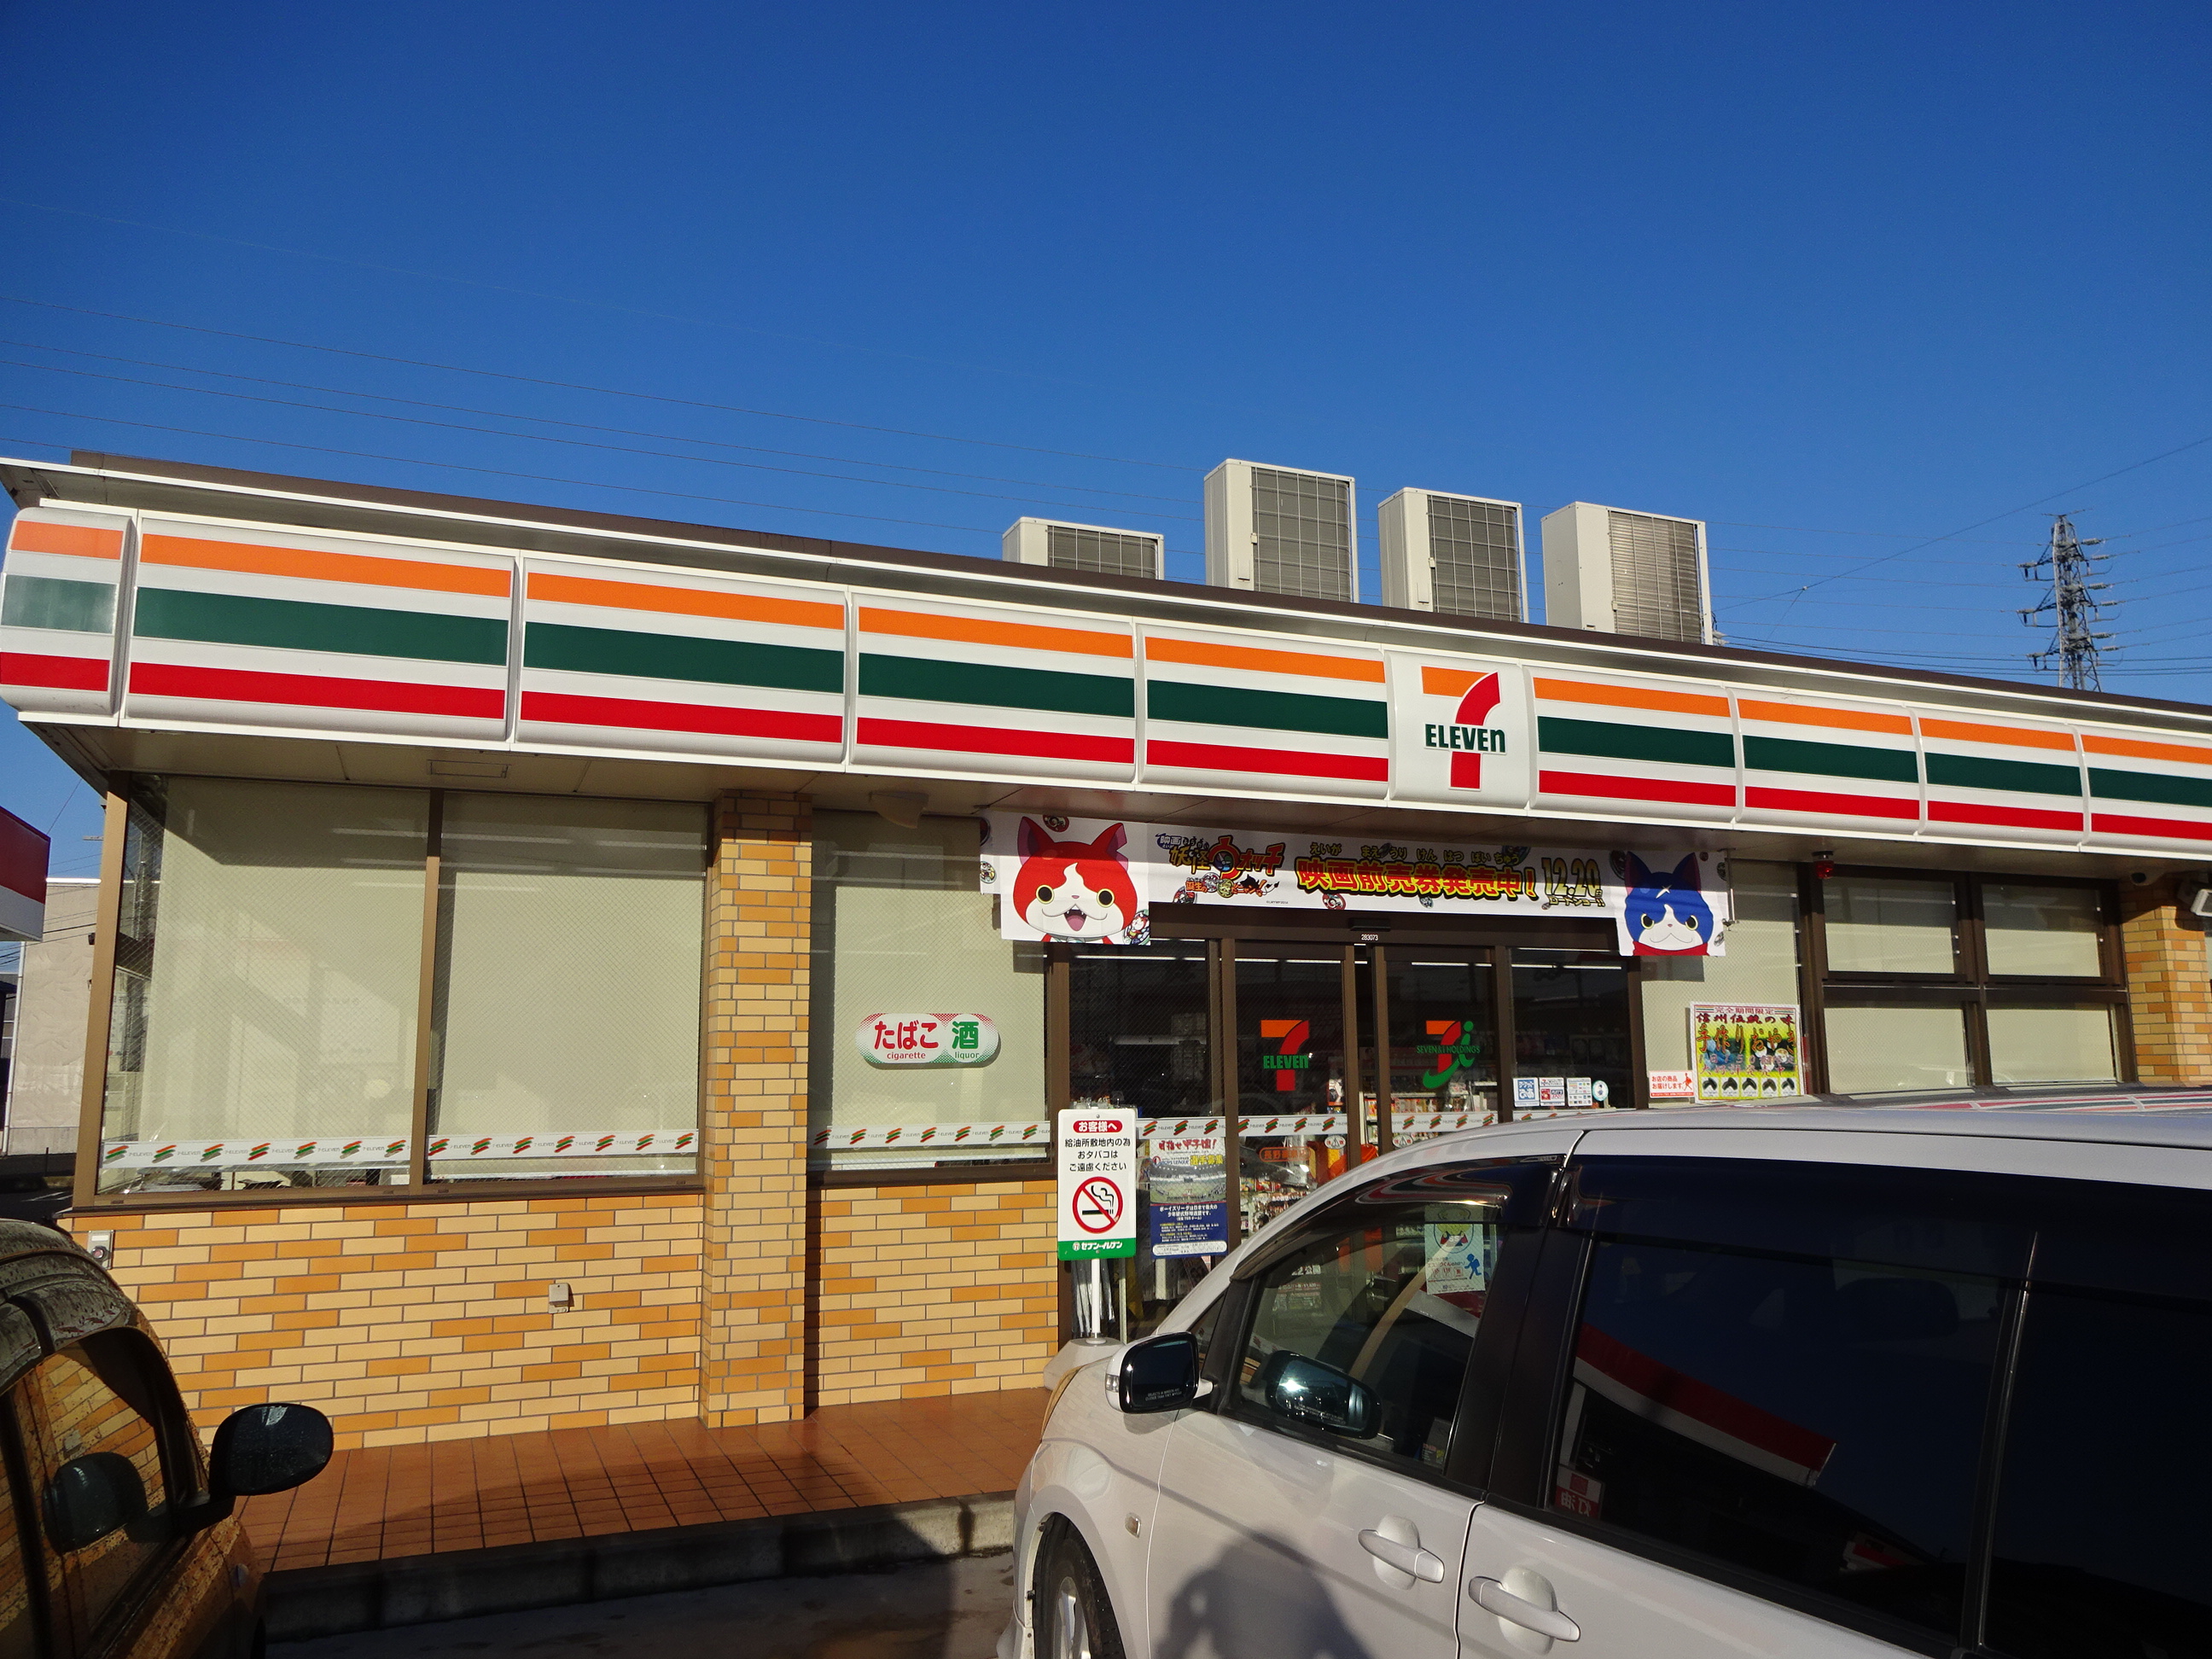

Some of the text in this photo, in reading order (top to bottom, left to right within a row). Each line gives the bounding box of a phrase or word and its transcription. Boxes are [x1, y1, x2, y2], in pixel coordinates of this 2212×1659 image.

[1310, 842, 1342, 856] えいが
[1417, 848, 1437, 862] けん
[1443, 850, 1464, 862] はつ
[1295, 857, 1539, 901] 映画前売券発売中!
[1541, 857, 1602, 897] 12.20
[1715, 1007, 1774, 1016] 完全期間限定
[874, 1020, 979, 1050] たばこ 酒
[1696, 1023, 1796, 1054] 手作りおやき
[887, 1051, 980, 1061] cigarette liquor
[1078, 1121, 1118, 1132] お客様へ
[1065, 1138, 1131, 1148] 給油所敷地内の為
[1078, 1150, 1118, 1159] おタバコは
[1069, 1162, 1126, 1172] ご遠慮ください
